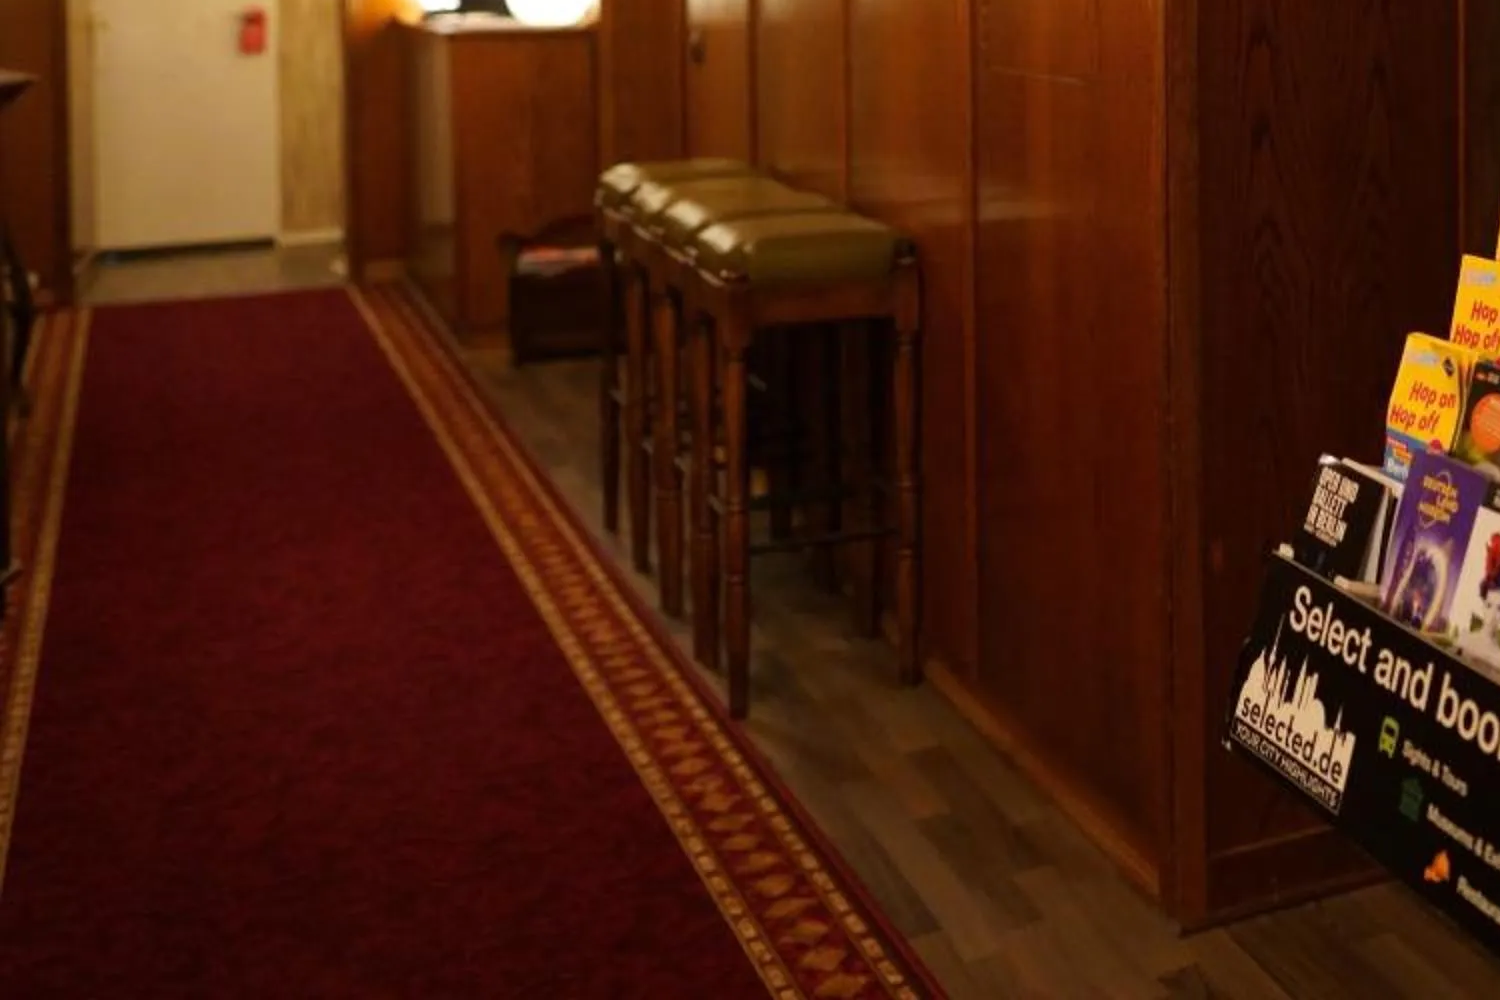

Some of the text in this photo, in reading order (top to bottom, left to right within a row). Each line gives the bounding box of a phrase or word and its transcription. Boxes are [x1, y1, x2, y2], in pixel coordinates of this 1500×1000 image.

[1471, 300, 1498, 326] Hop
[1453, 324, 1481, 350] Hop
[1409, 380, 1456, 409] Hop on
[1390, 404, 1441, 435] Hop off
[1289, 584, 1374, 674] Select
[1374, 645, 1434, 712] and
[1240, 696, 1344, 784] selected.de
